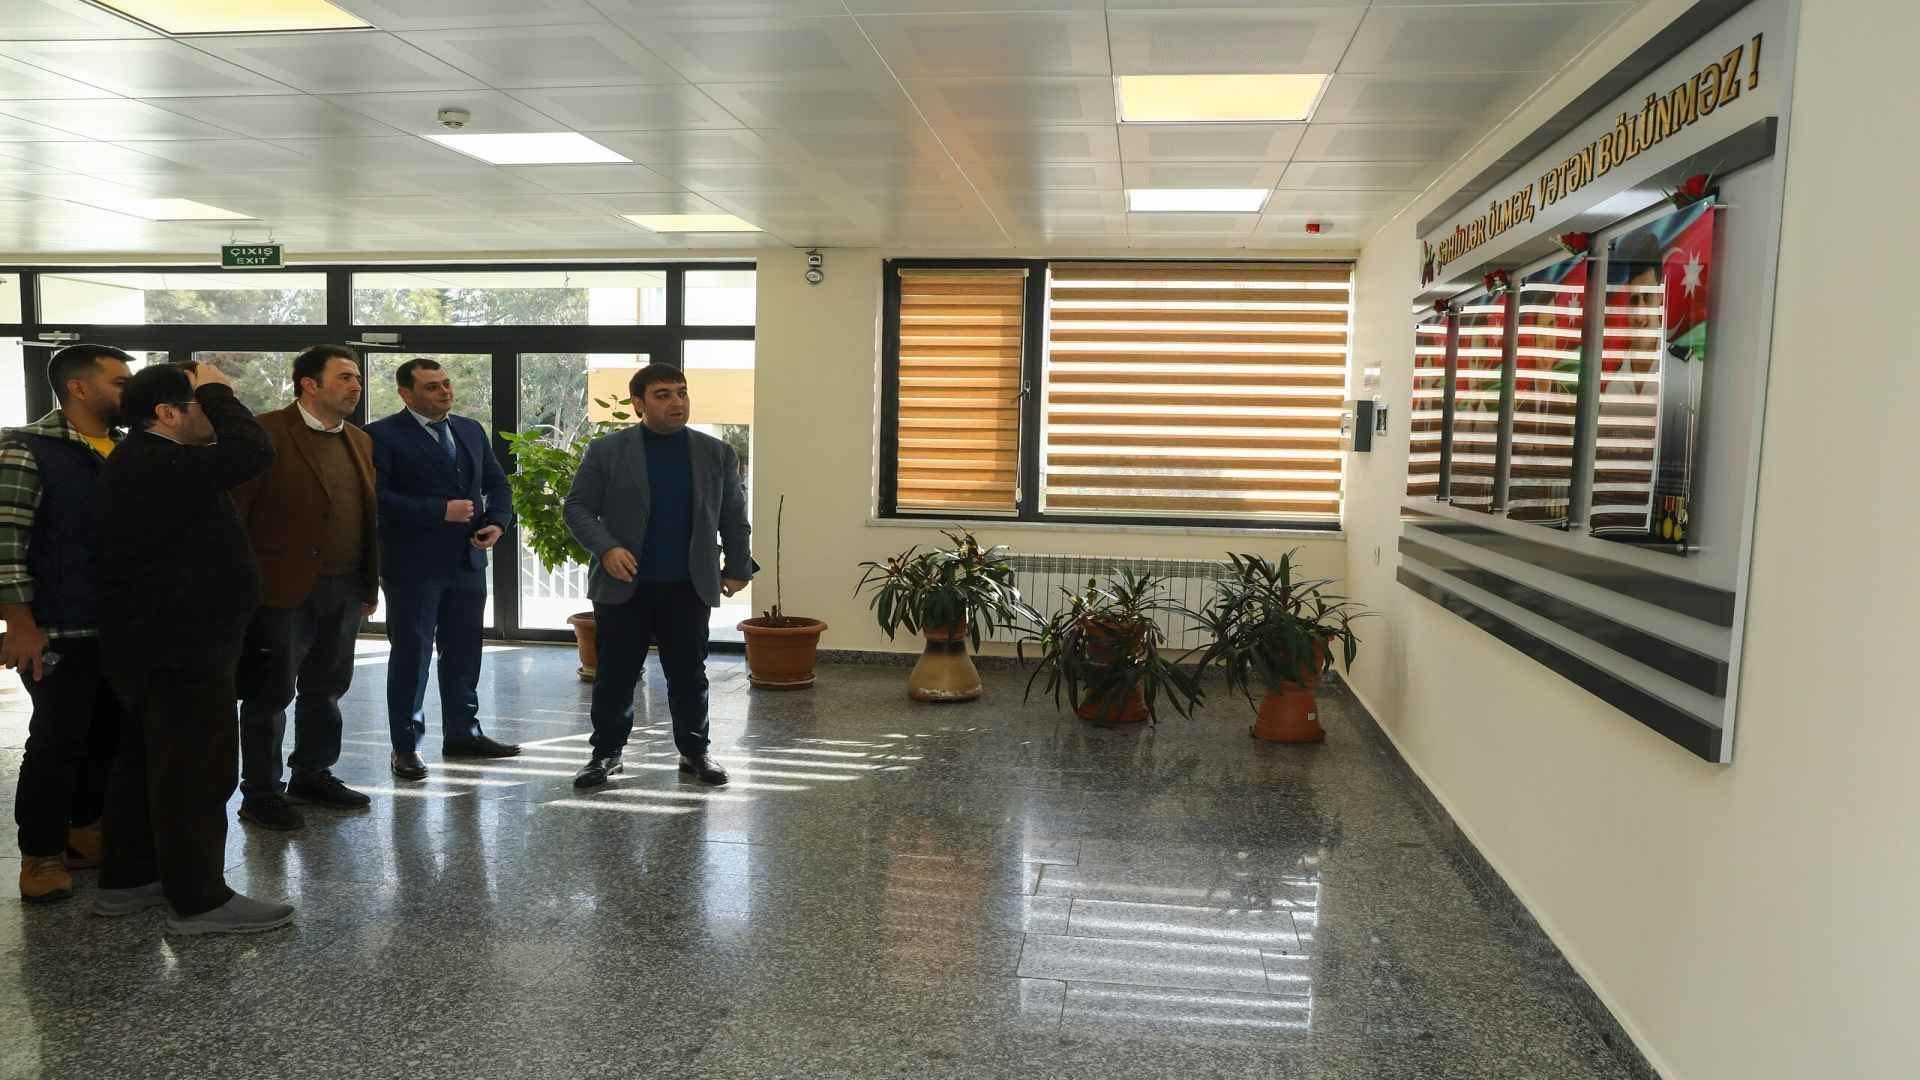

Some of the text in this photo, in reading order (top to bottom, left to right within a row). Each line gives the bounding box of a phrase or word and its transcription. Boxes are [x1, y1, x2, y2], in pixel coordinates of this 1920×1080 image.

[1488, 183, 1536, 240] ÖLMƏZ,
[1537, 141, 1597, 211] VƏTƏN
[1597, 43, 1745, 178] BÖLÜNMƏZ
[236, 257, 268, 265] EXIT
